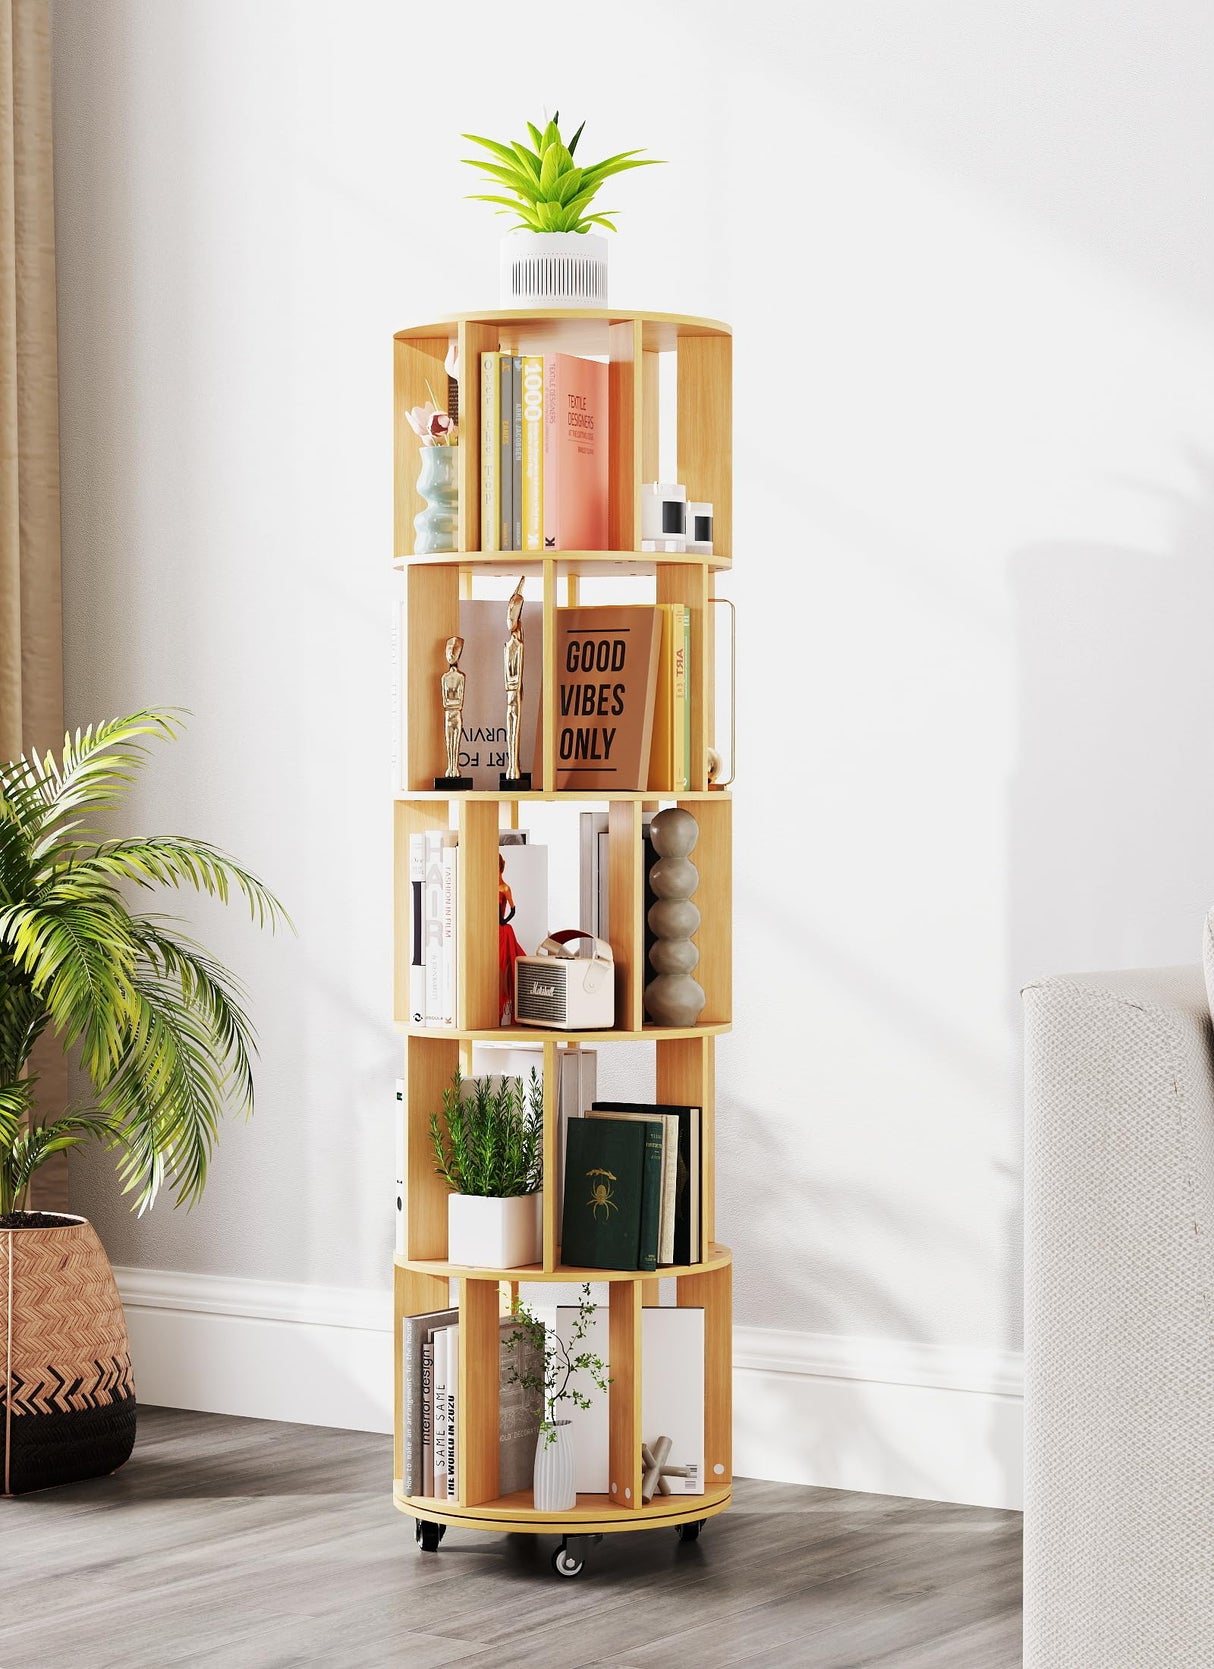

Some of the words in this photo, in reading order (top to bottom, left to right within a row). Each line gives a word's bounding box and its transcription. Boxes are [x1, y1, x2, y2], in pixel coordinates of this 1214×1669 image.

[524, 363, 543, 421] 1000
[567, 394, 587, 411] TEXTILE
[567, 412, 594, 430] DESIGNERS
[566, 640, 626, 673] GOOD
[560, 683, 626, 716] VIBES
[487, 752, 509, 767] RT
[559, 728, 617, 760] ONLY
[529, 981, 555, 997] Marshall
[406, 1364, 413, 1373] in
[422, 1349, 434, 1394] design
[406, 1377, 414, 1425] arrangement
[436, 1383, 446, 1421] SAME
[422, 1398, 431, 1446] Interior
[448, 1424, 455, 1436] IN
[436, 1430, 446, 1467] SAME
[406, 1463, 413, 1472] to
